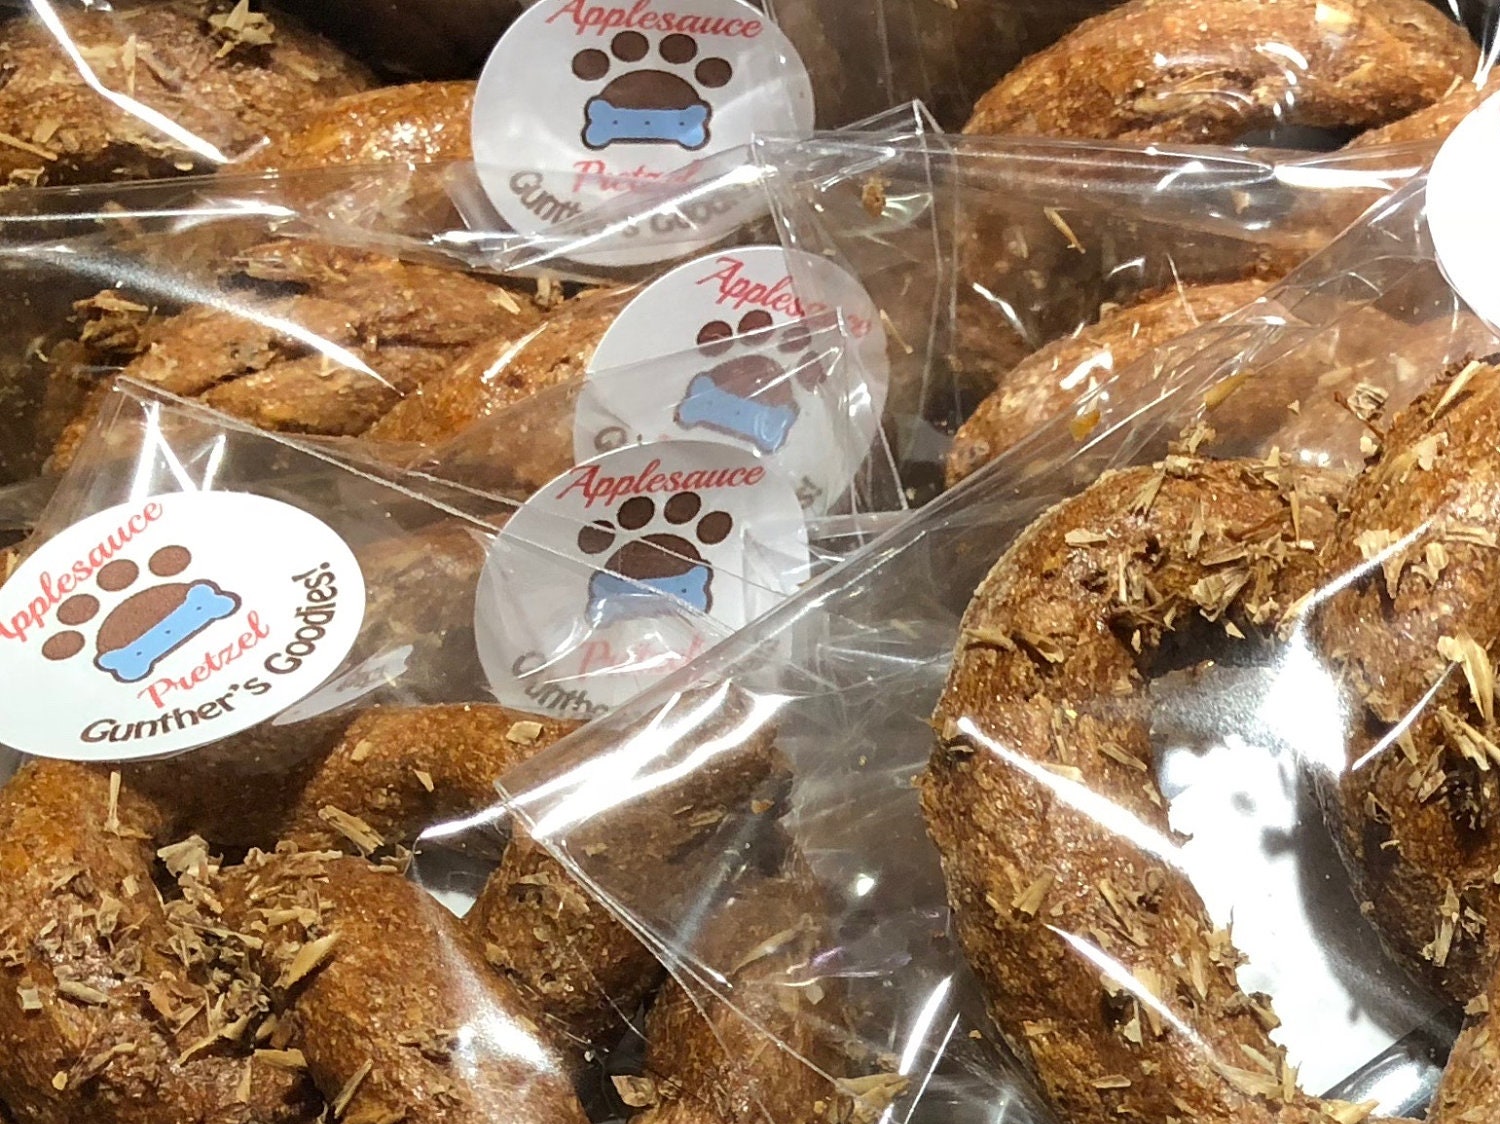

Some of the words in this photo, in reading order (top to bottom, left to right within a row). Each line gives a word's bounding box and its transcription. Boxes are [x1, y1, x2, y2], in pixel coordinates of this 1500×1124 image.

[545, 0, 764, 38] Applesauce
[556, 458, 767, 509] Applesauce
[79, 676, 273, 744] Gunther's
[263, 561, 339, 675] Goodies!
[136, 610, 270, 710] Pretzel
